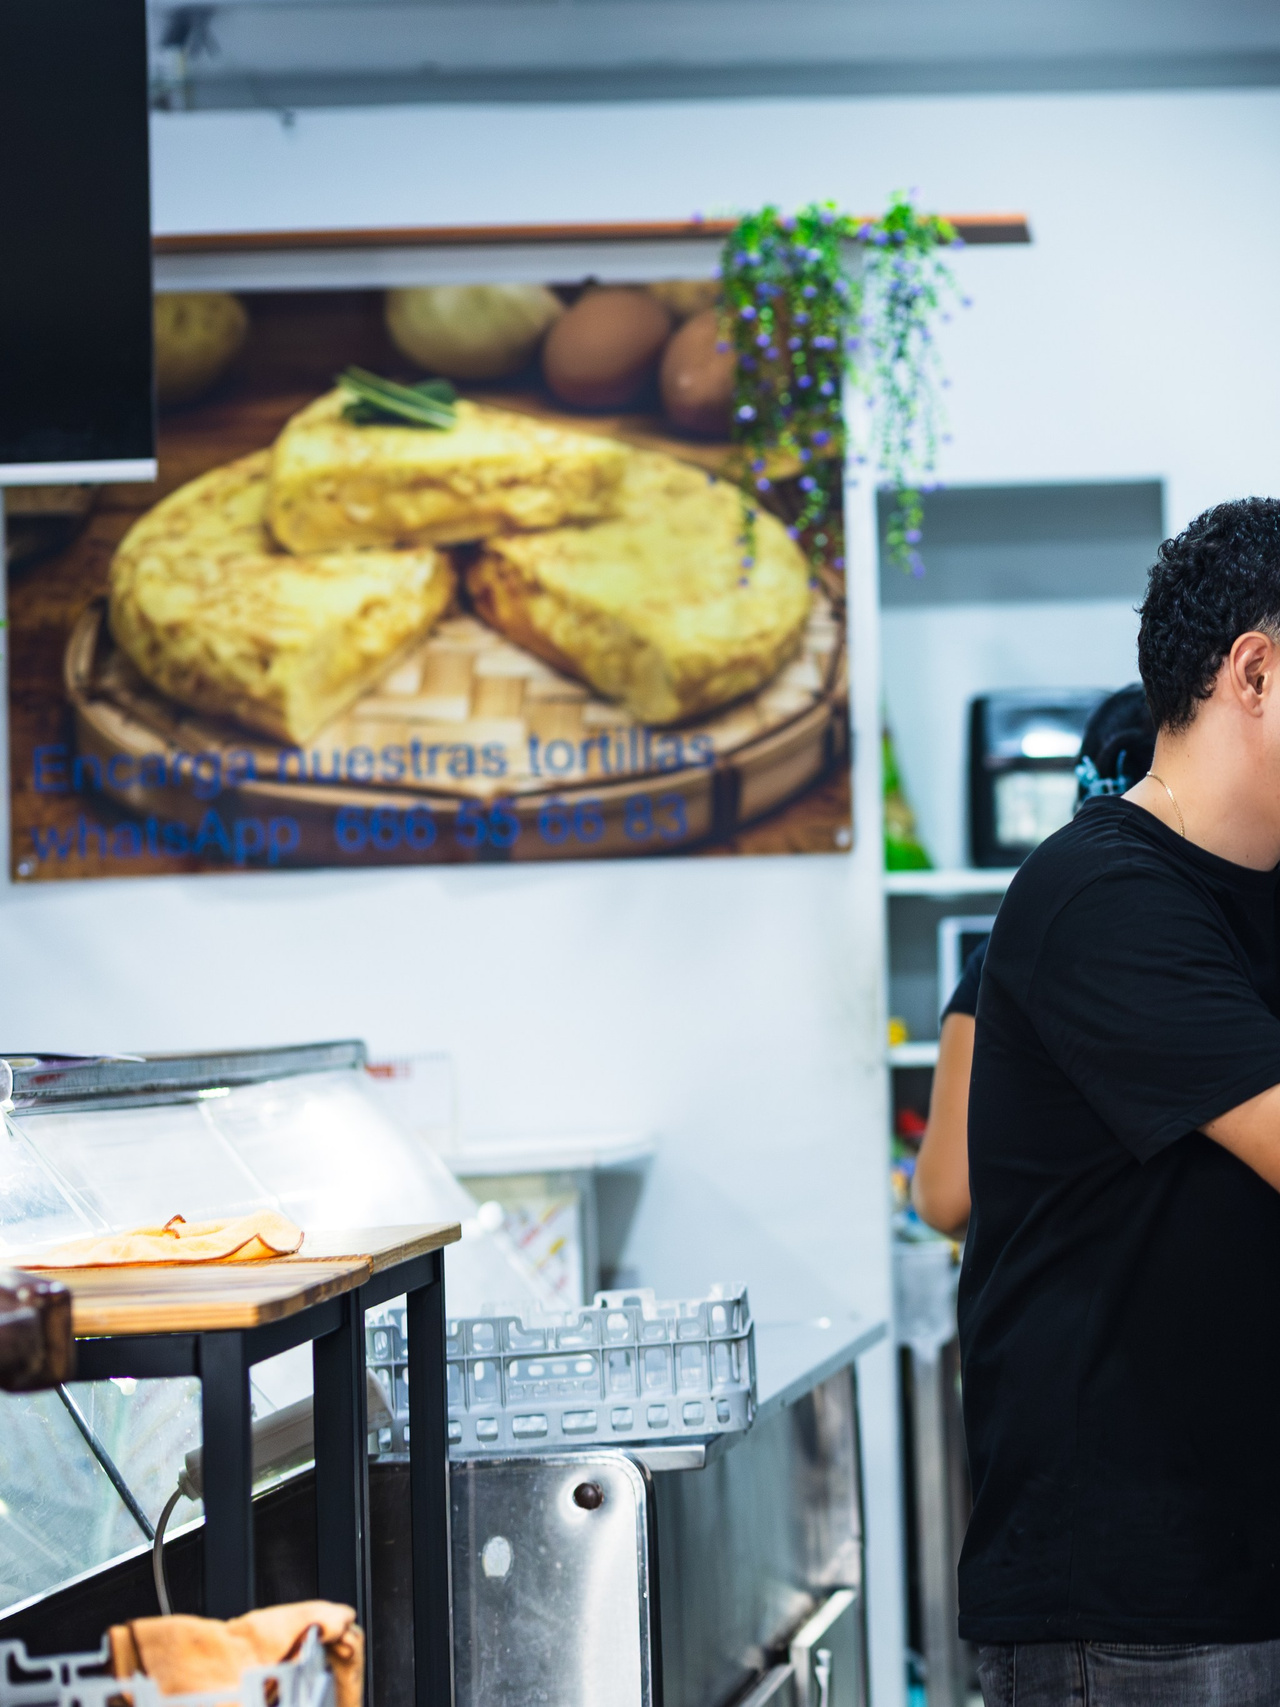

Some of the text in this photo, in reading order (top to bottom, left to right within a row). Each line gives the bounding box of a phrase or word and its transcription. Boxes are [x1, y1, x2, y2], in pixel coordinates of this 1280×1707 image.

[33, 727, 716, 799] Encarga nuestras tortillas
[31, 792, 689, 867] whatsApp 666 55 66 83
